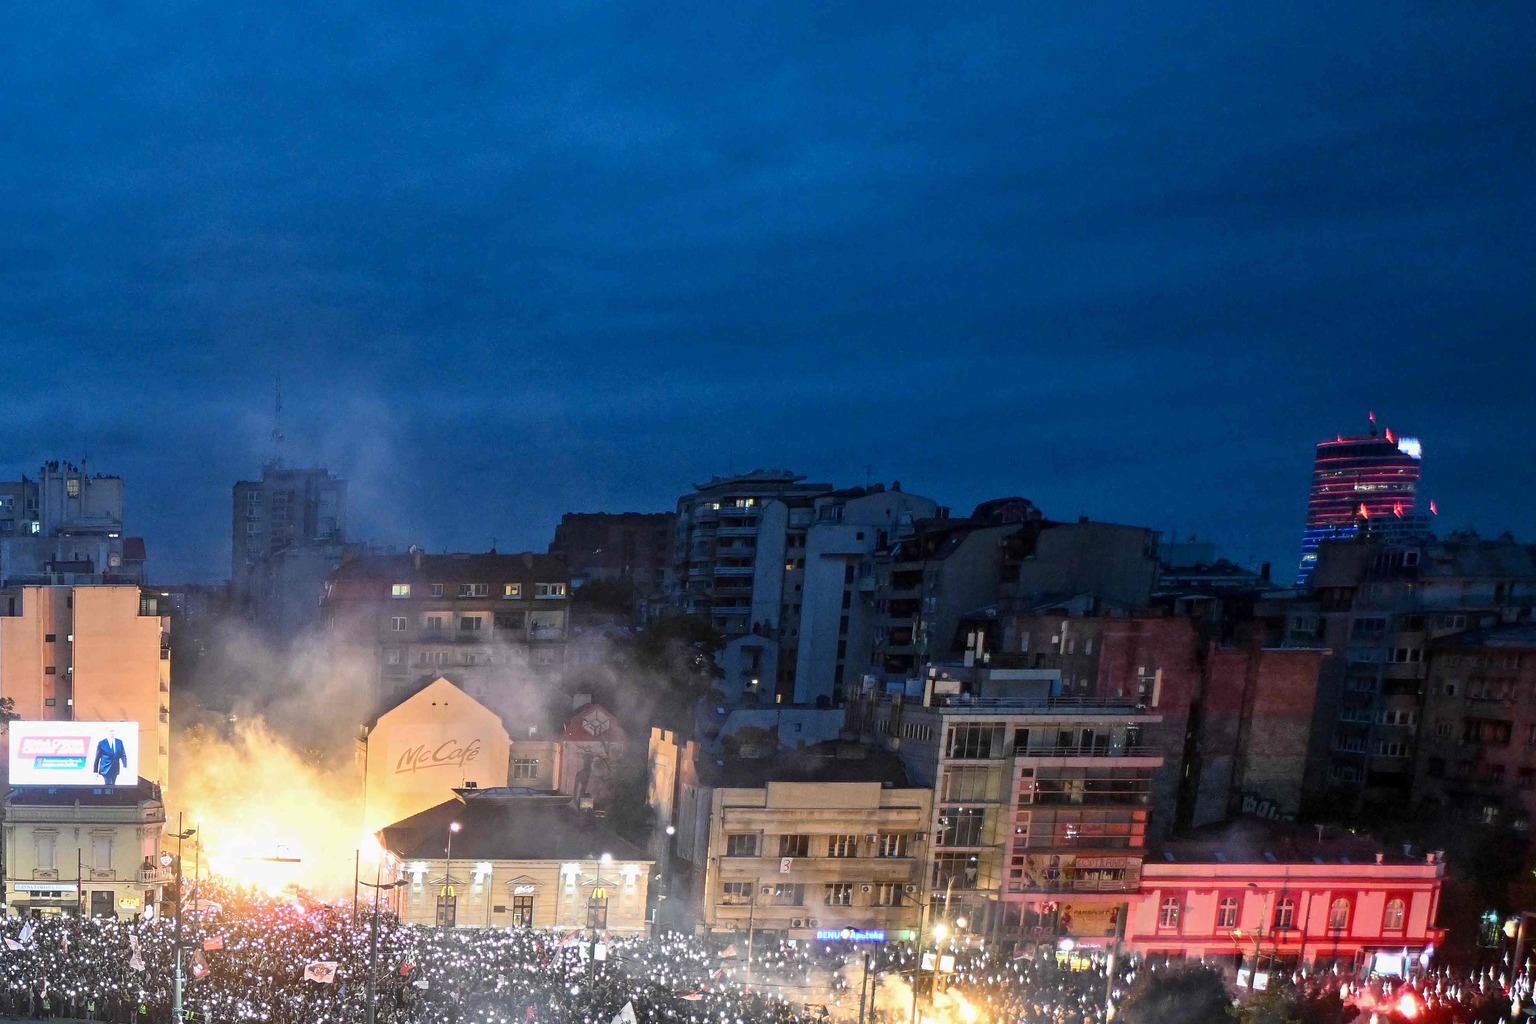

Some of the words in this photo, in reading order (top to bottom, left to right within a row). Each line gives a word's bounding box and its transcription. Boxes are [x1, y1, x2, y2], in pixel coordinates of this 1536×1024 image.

[395, 738, 481, 773] McCafé
[784, 859, 791, 872] 3
[816, 930, 840, 940] BENU
